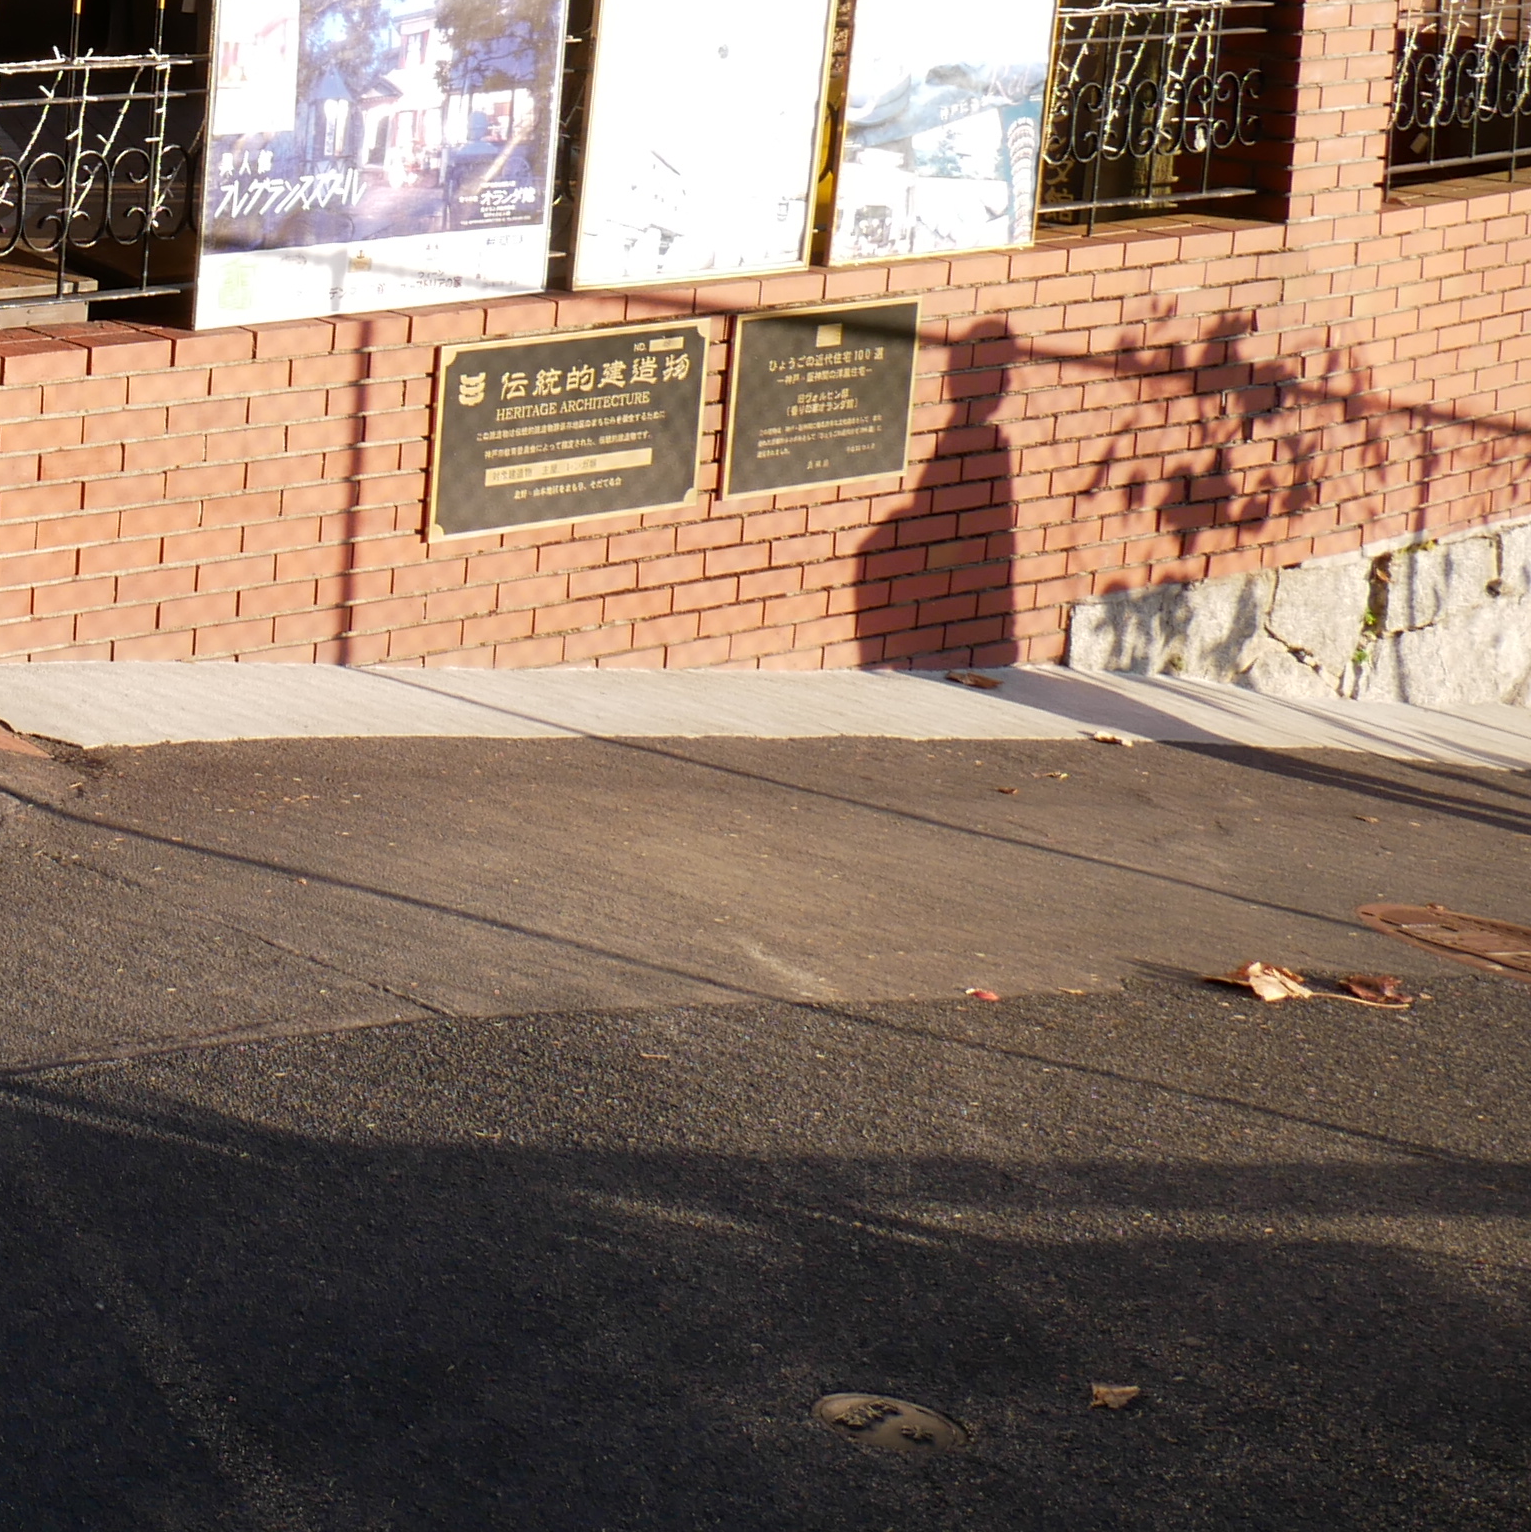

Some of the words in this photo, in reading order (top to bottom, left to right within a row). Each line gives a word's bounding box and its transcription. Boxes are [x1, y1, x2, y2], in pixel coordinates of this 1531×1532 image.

[214, 168, 368, 218] フレグランススクール
[480, 186, 536, 206] オランダ館
[401, 274, 463, 289] ーストリアの家
[500, 352, 691, 399] 伝統的建造物
[496, 402, 558, 422] HERITAGE
[559, 390, 651, 415] ARCHITECTURE
